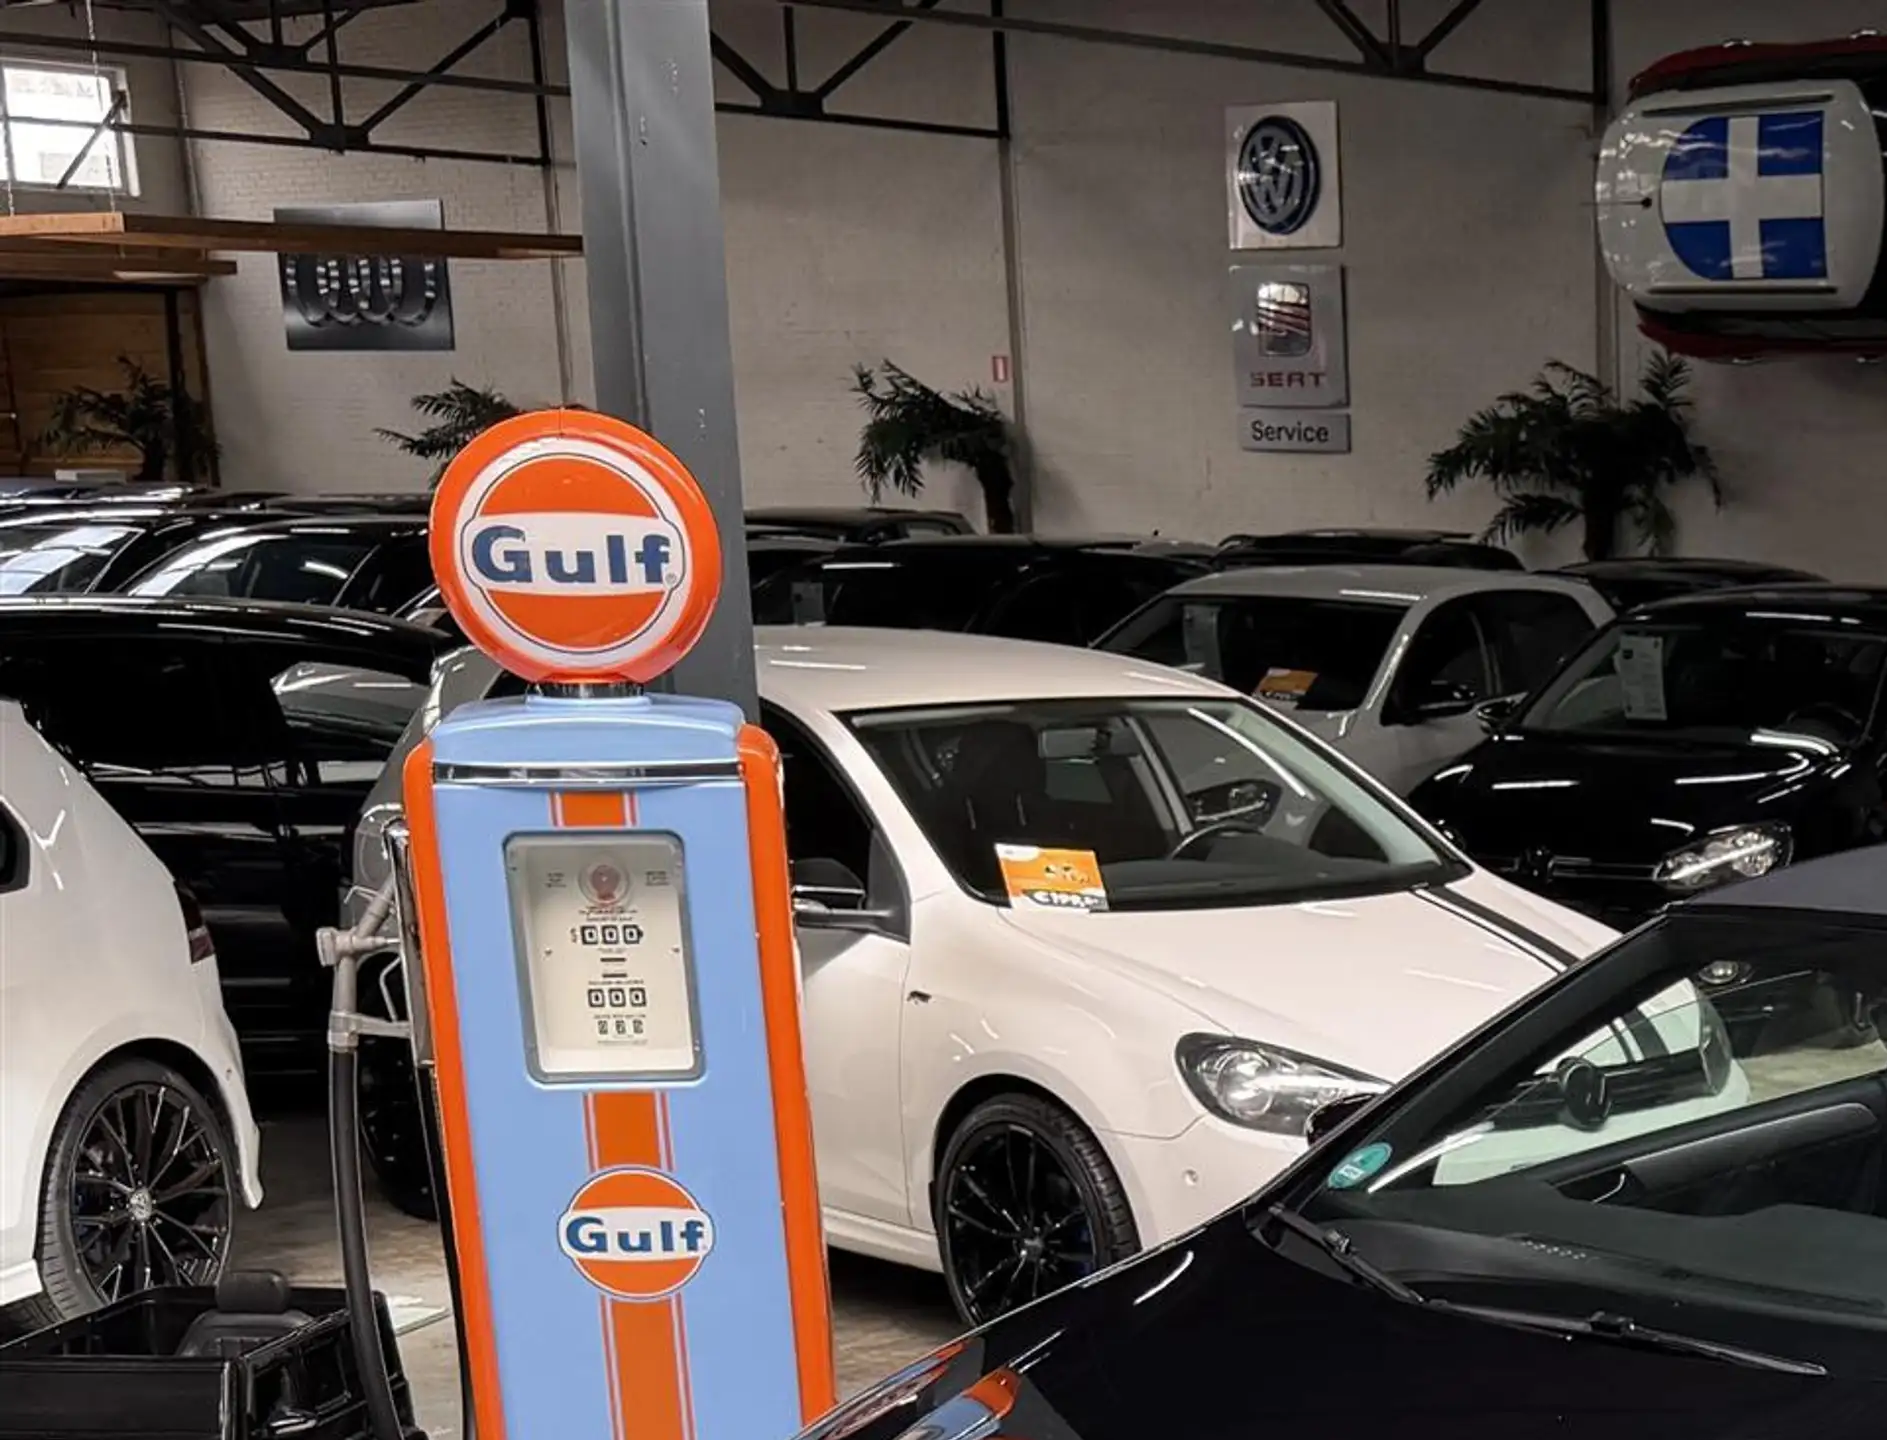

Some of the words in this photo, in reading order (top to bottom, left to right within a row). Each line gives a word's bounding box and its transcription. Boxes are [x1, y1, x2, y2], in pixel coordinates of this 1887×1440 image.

[1250, 371, 1327, 388] SEAT
[1251, 421, 1329, 444] Service
[471, 525, 671, 584] Gulf
[565, 1216, 705, 1253] Gulf
